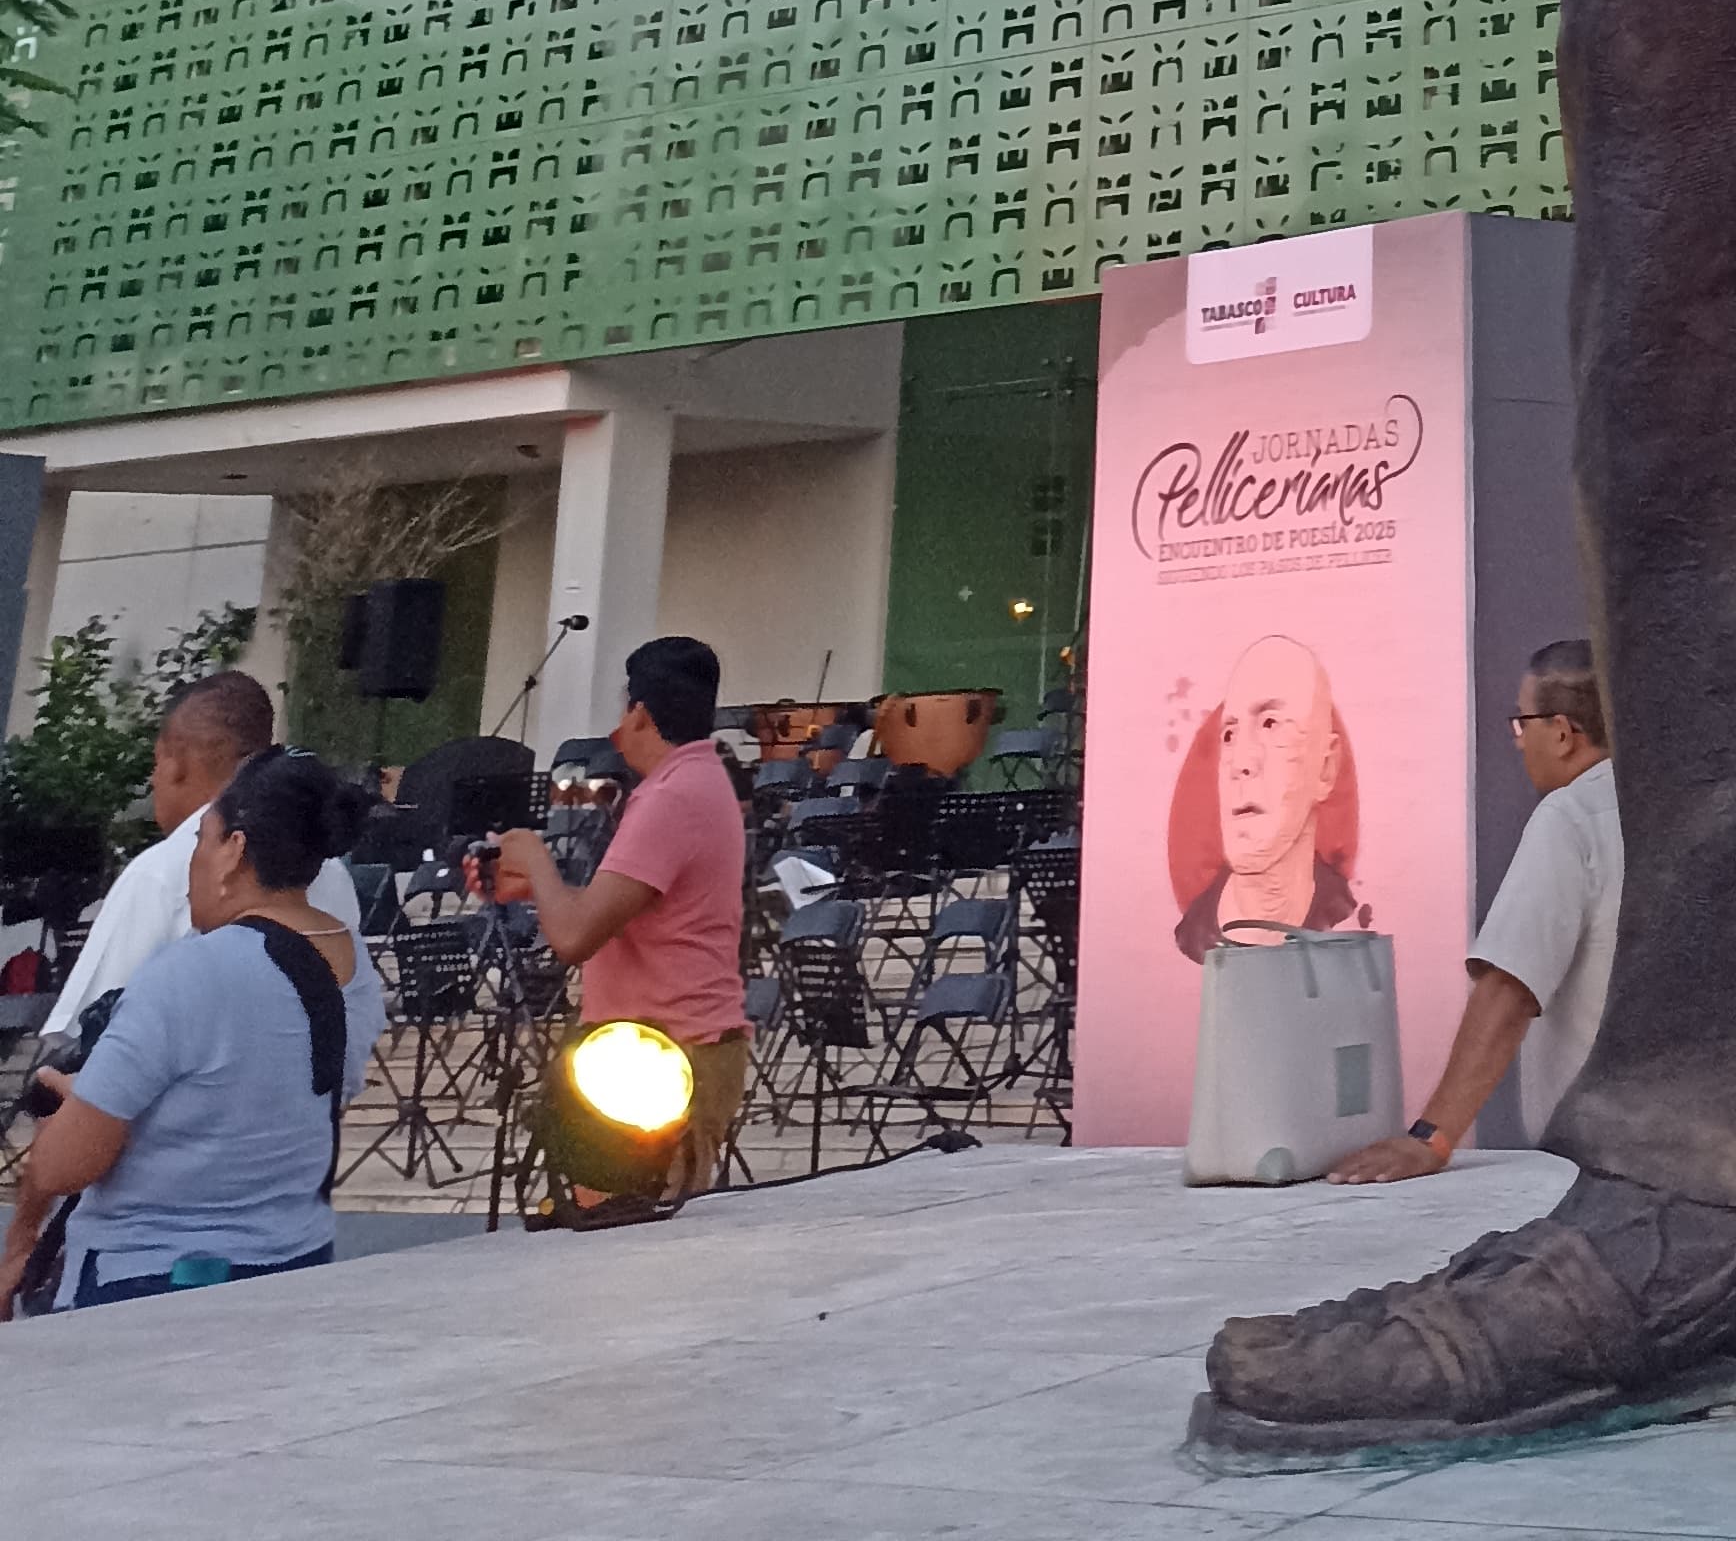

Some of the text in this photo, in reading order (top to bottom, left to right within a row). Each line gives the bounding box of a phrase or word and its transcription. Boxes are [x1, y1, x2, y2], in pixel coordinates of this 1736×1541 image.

[1201, 299, 1263, 323] TABASCO
[1293, 284, 1356, 309] CULTURA
[1251, 419, 1400, 464] JORNADAS
[1158, 519, 1397, 563] ENCUENTRO DE POESÍA 2025
